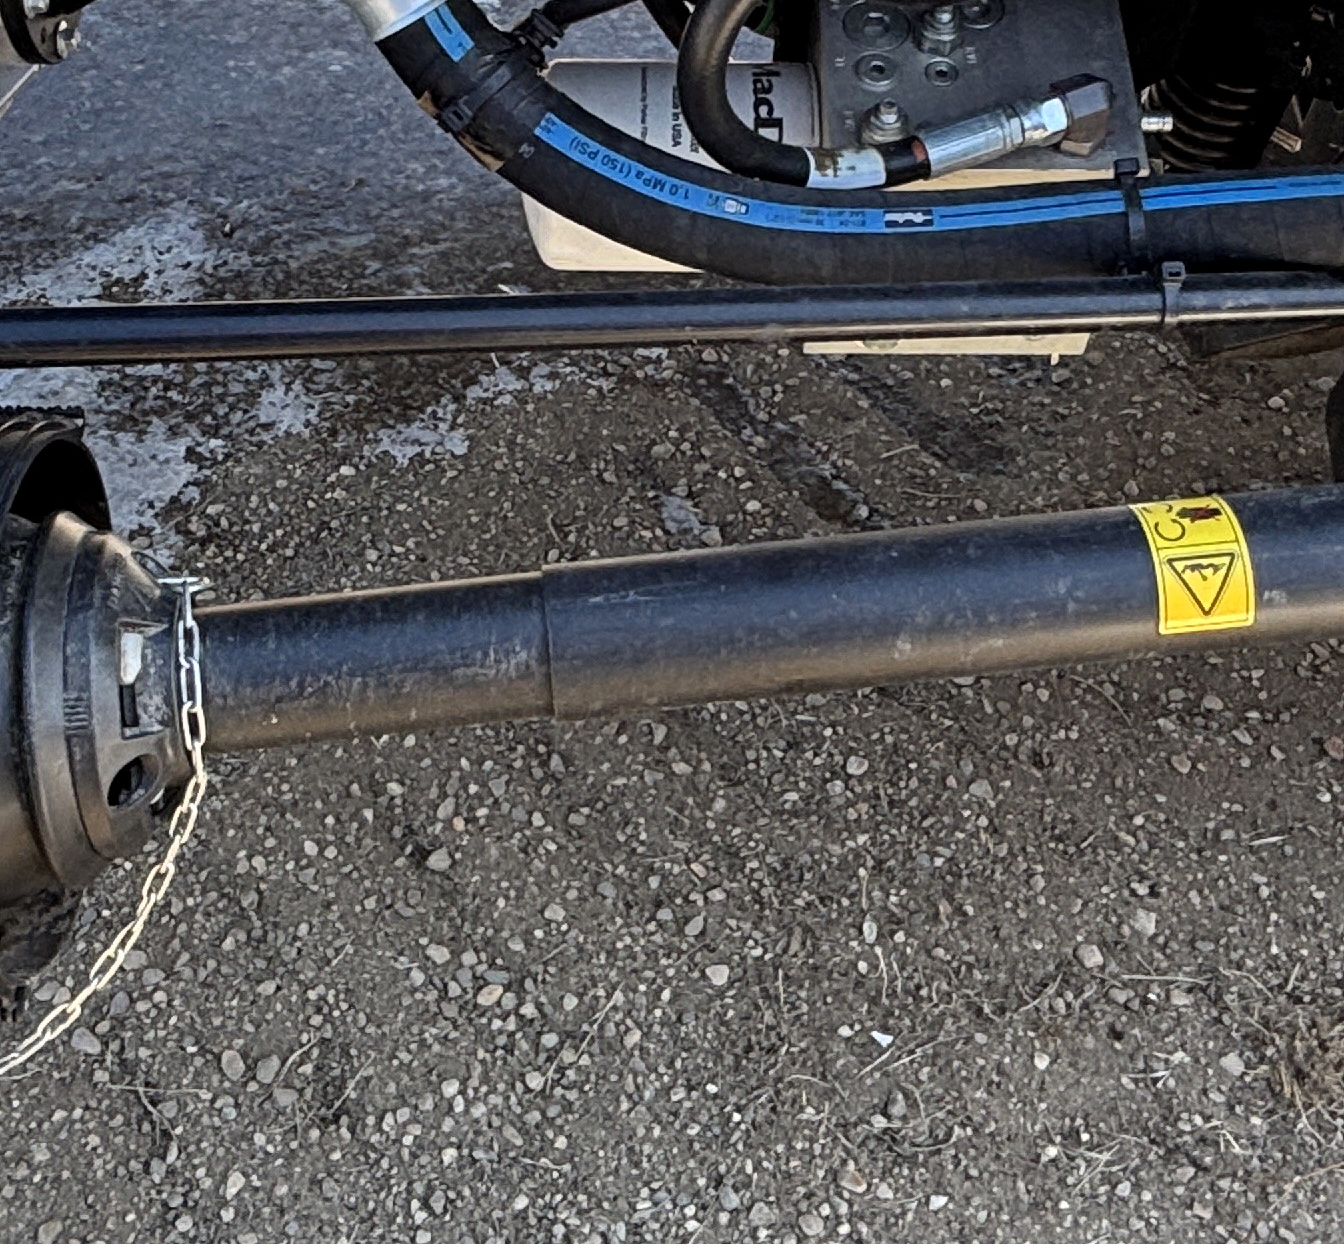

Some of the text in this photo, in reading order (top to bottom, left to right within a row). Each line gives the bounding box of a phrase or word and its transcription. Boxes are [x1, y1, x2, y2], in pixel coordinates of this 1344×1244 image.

[671, 122, 683, 147] USA
[568, 136, 601, 166] PSI)
[599, 151, 633, 178] (150
[633, 168, 669, 196] MPa
